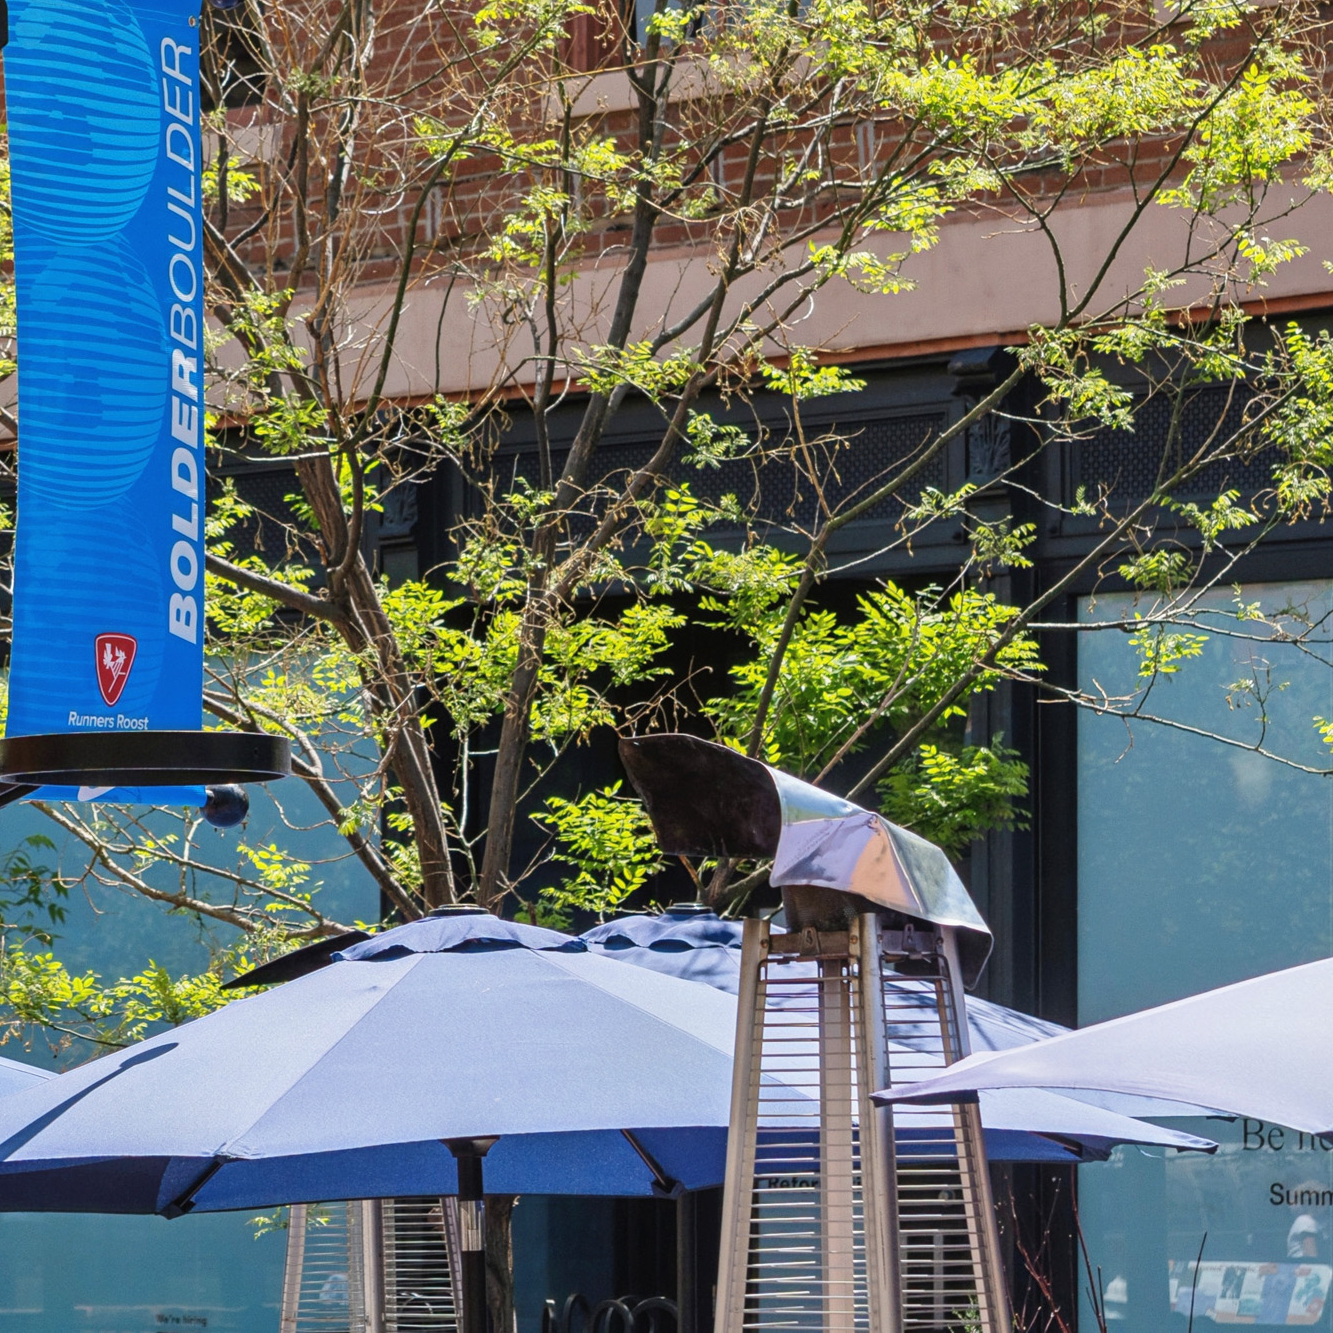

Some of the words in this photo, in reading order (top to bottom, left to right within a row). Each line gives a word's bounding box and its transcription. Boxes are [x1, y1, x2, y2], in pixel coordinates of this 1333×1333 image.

[161, 36, 200, 645] BOLDERBOULDER
[68, 711, 115, 728] Runners
[116, 714, 149, 730] Roost
[1242, 1118, 1284, 1151] Be
